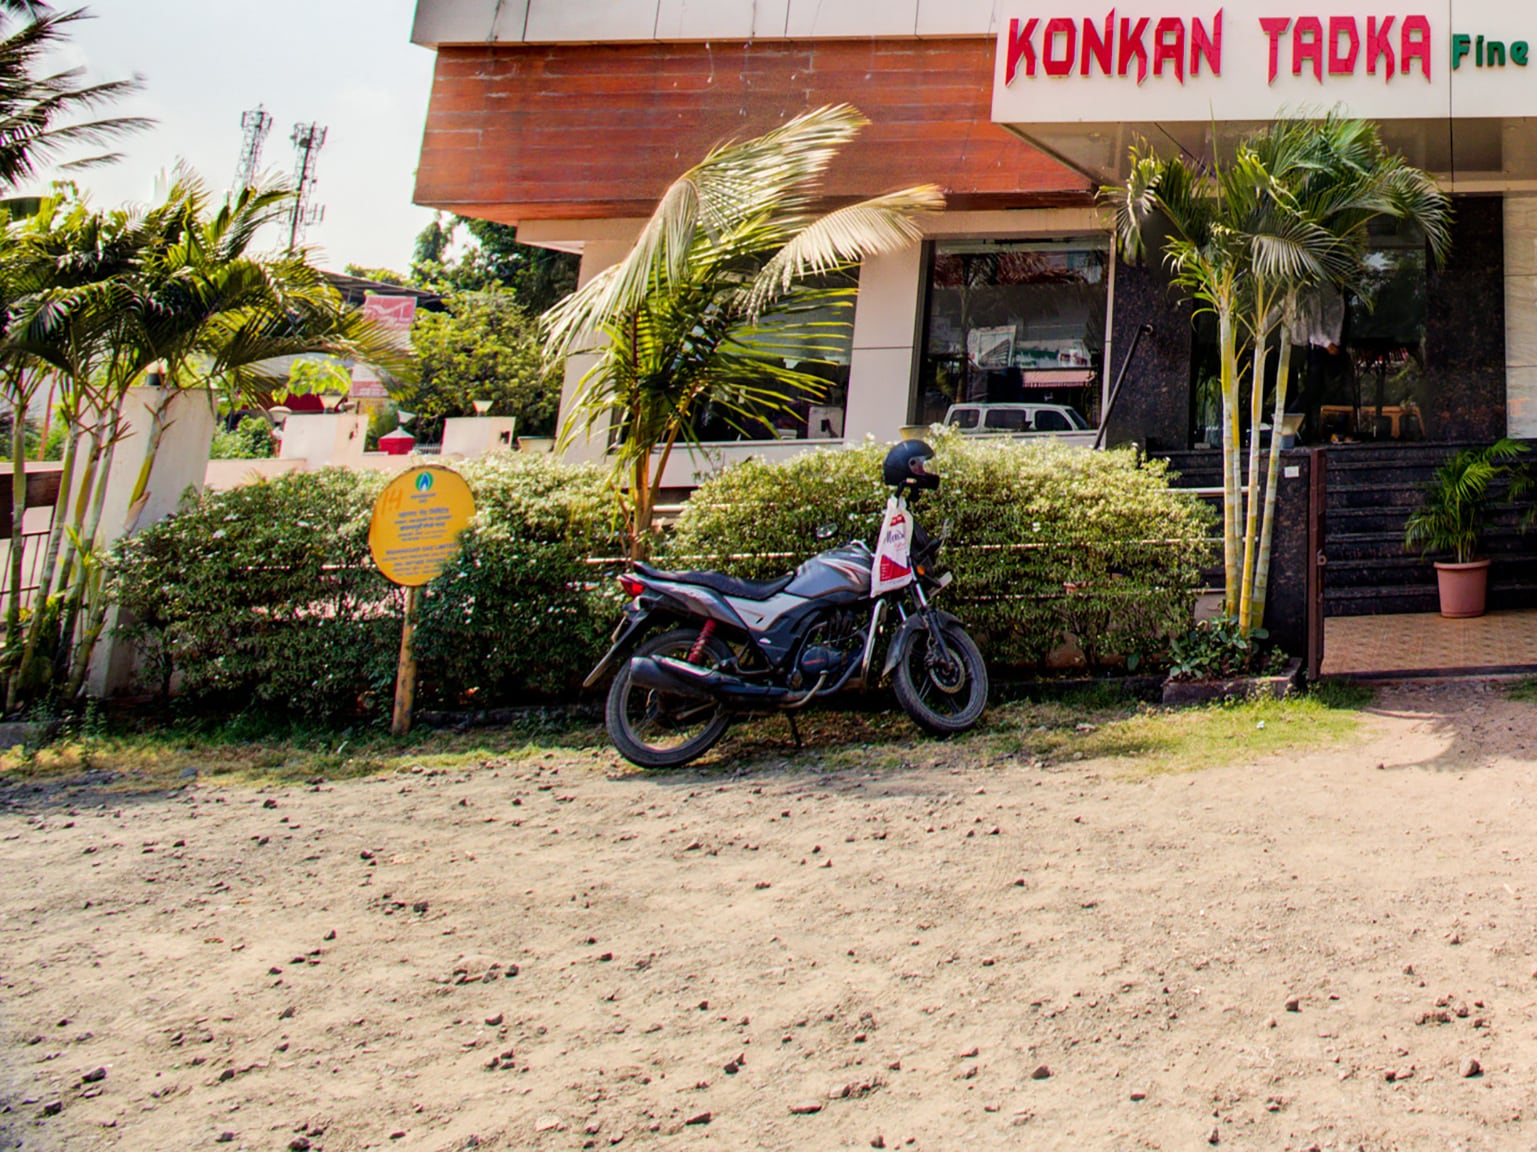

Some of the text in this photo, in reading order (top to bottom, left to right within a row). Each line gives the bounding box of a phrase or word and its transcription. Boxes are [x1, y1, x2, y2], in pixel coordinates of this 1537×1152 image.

[1004, 7, 1223, 87] KONKAN
[1257, 14, 1431, 87] TADKA
[1452, 33, 1530, 70] Fine
